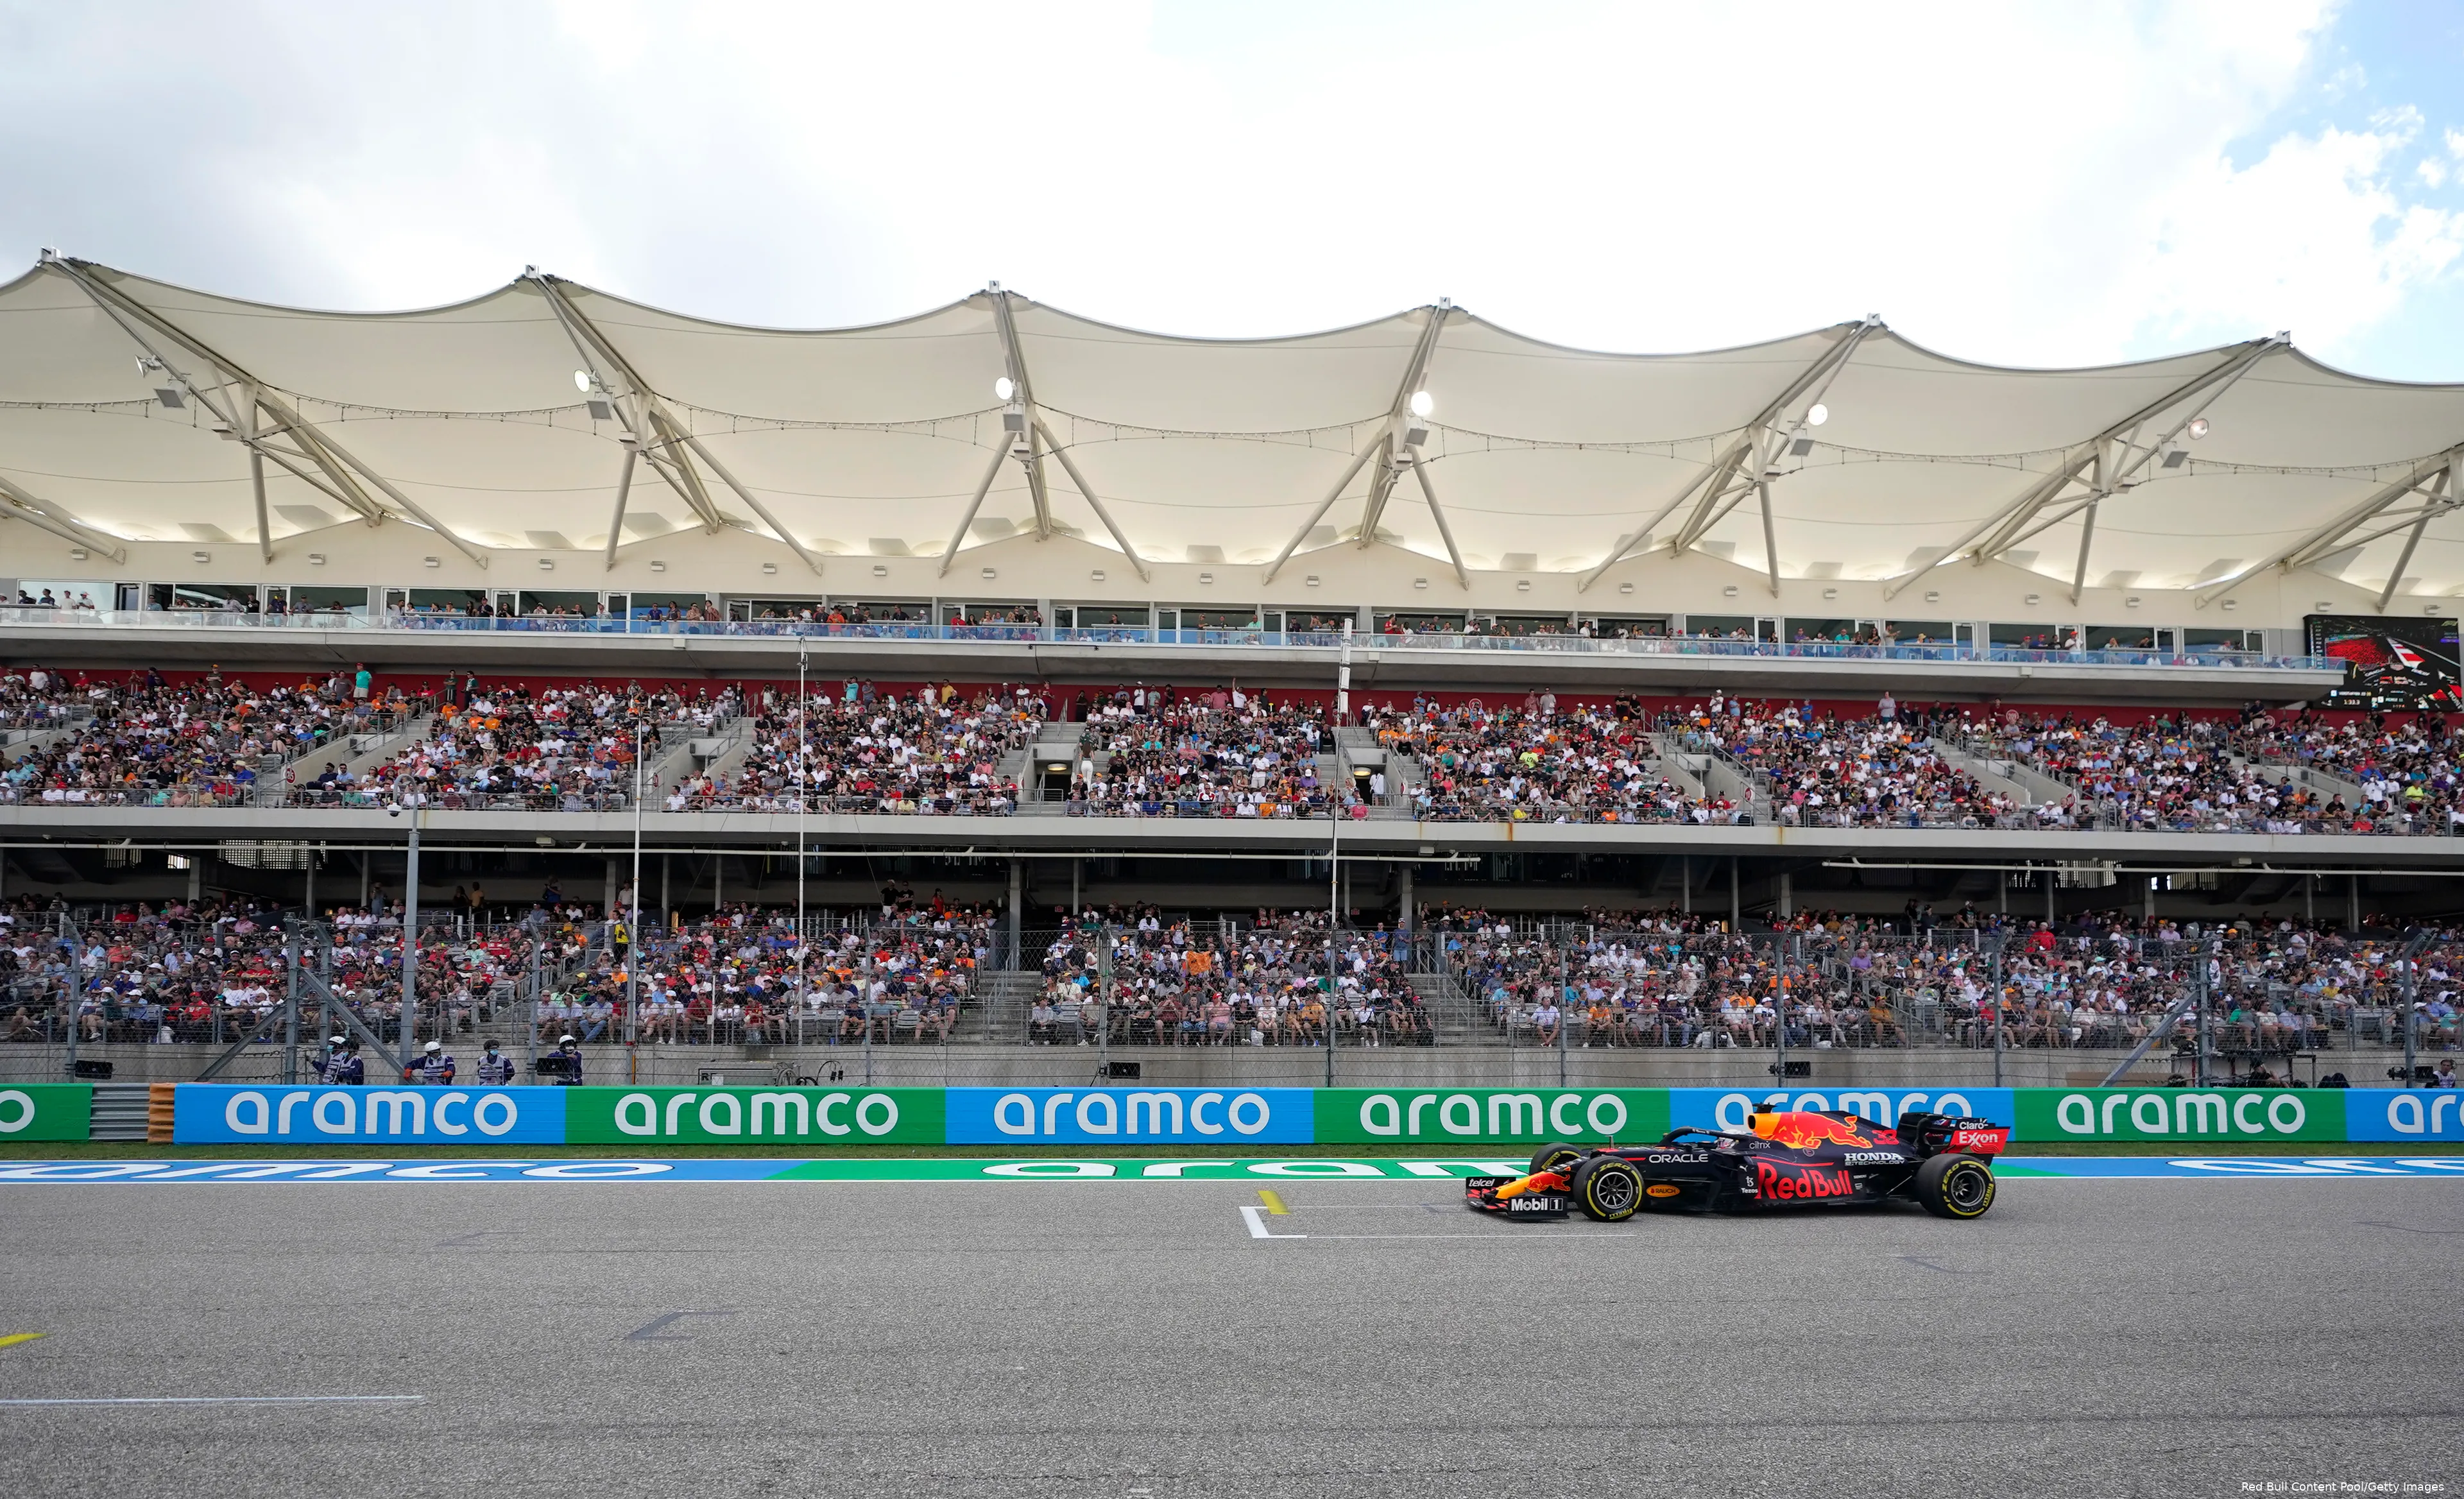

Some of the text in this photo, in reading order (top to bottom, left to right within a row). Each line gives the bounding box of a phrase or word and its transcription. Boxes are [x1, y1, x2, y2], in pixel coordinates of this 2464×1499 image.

[226, 1091, 518, 1136] aramco
[615, 1092, 898, 1135] aramco
[994, 1092, 1270, 1135] aramco
[1360, 1093, 1627, 1135] aramco
[2057, 1093, 2306, 1133] aramco
[2387, 1094, 2464, 1133] ar
[1749, 1141, 1770, 1149] citrix
[1959, 1131, 1998, 1147] Exxon
[1649, 1154, 1708, 1163] ORACLE
[0, 1163, 674, 1178] amco
[982, 1162, 1531, 1176] aram
[1598, 1163, 1631, 1172] ZERO
[1468, 1179, 1495, 1187] telcel
[1942, 1163, 1960, 1192] ZERO
[1510, 1198, 1548, 1212] Mobil
